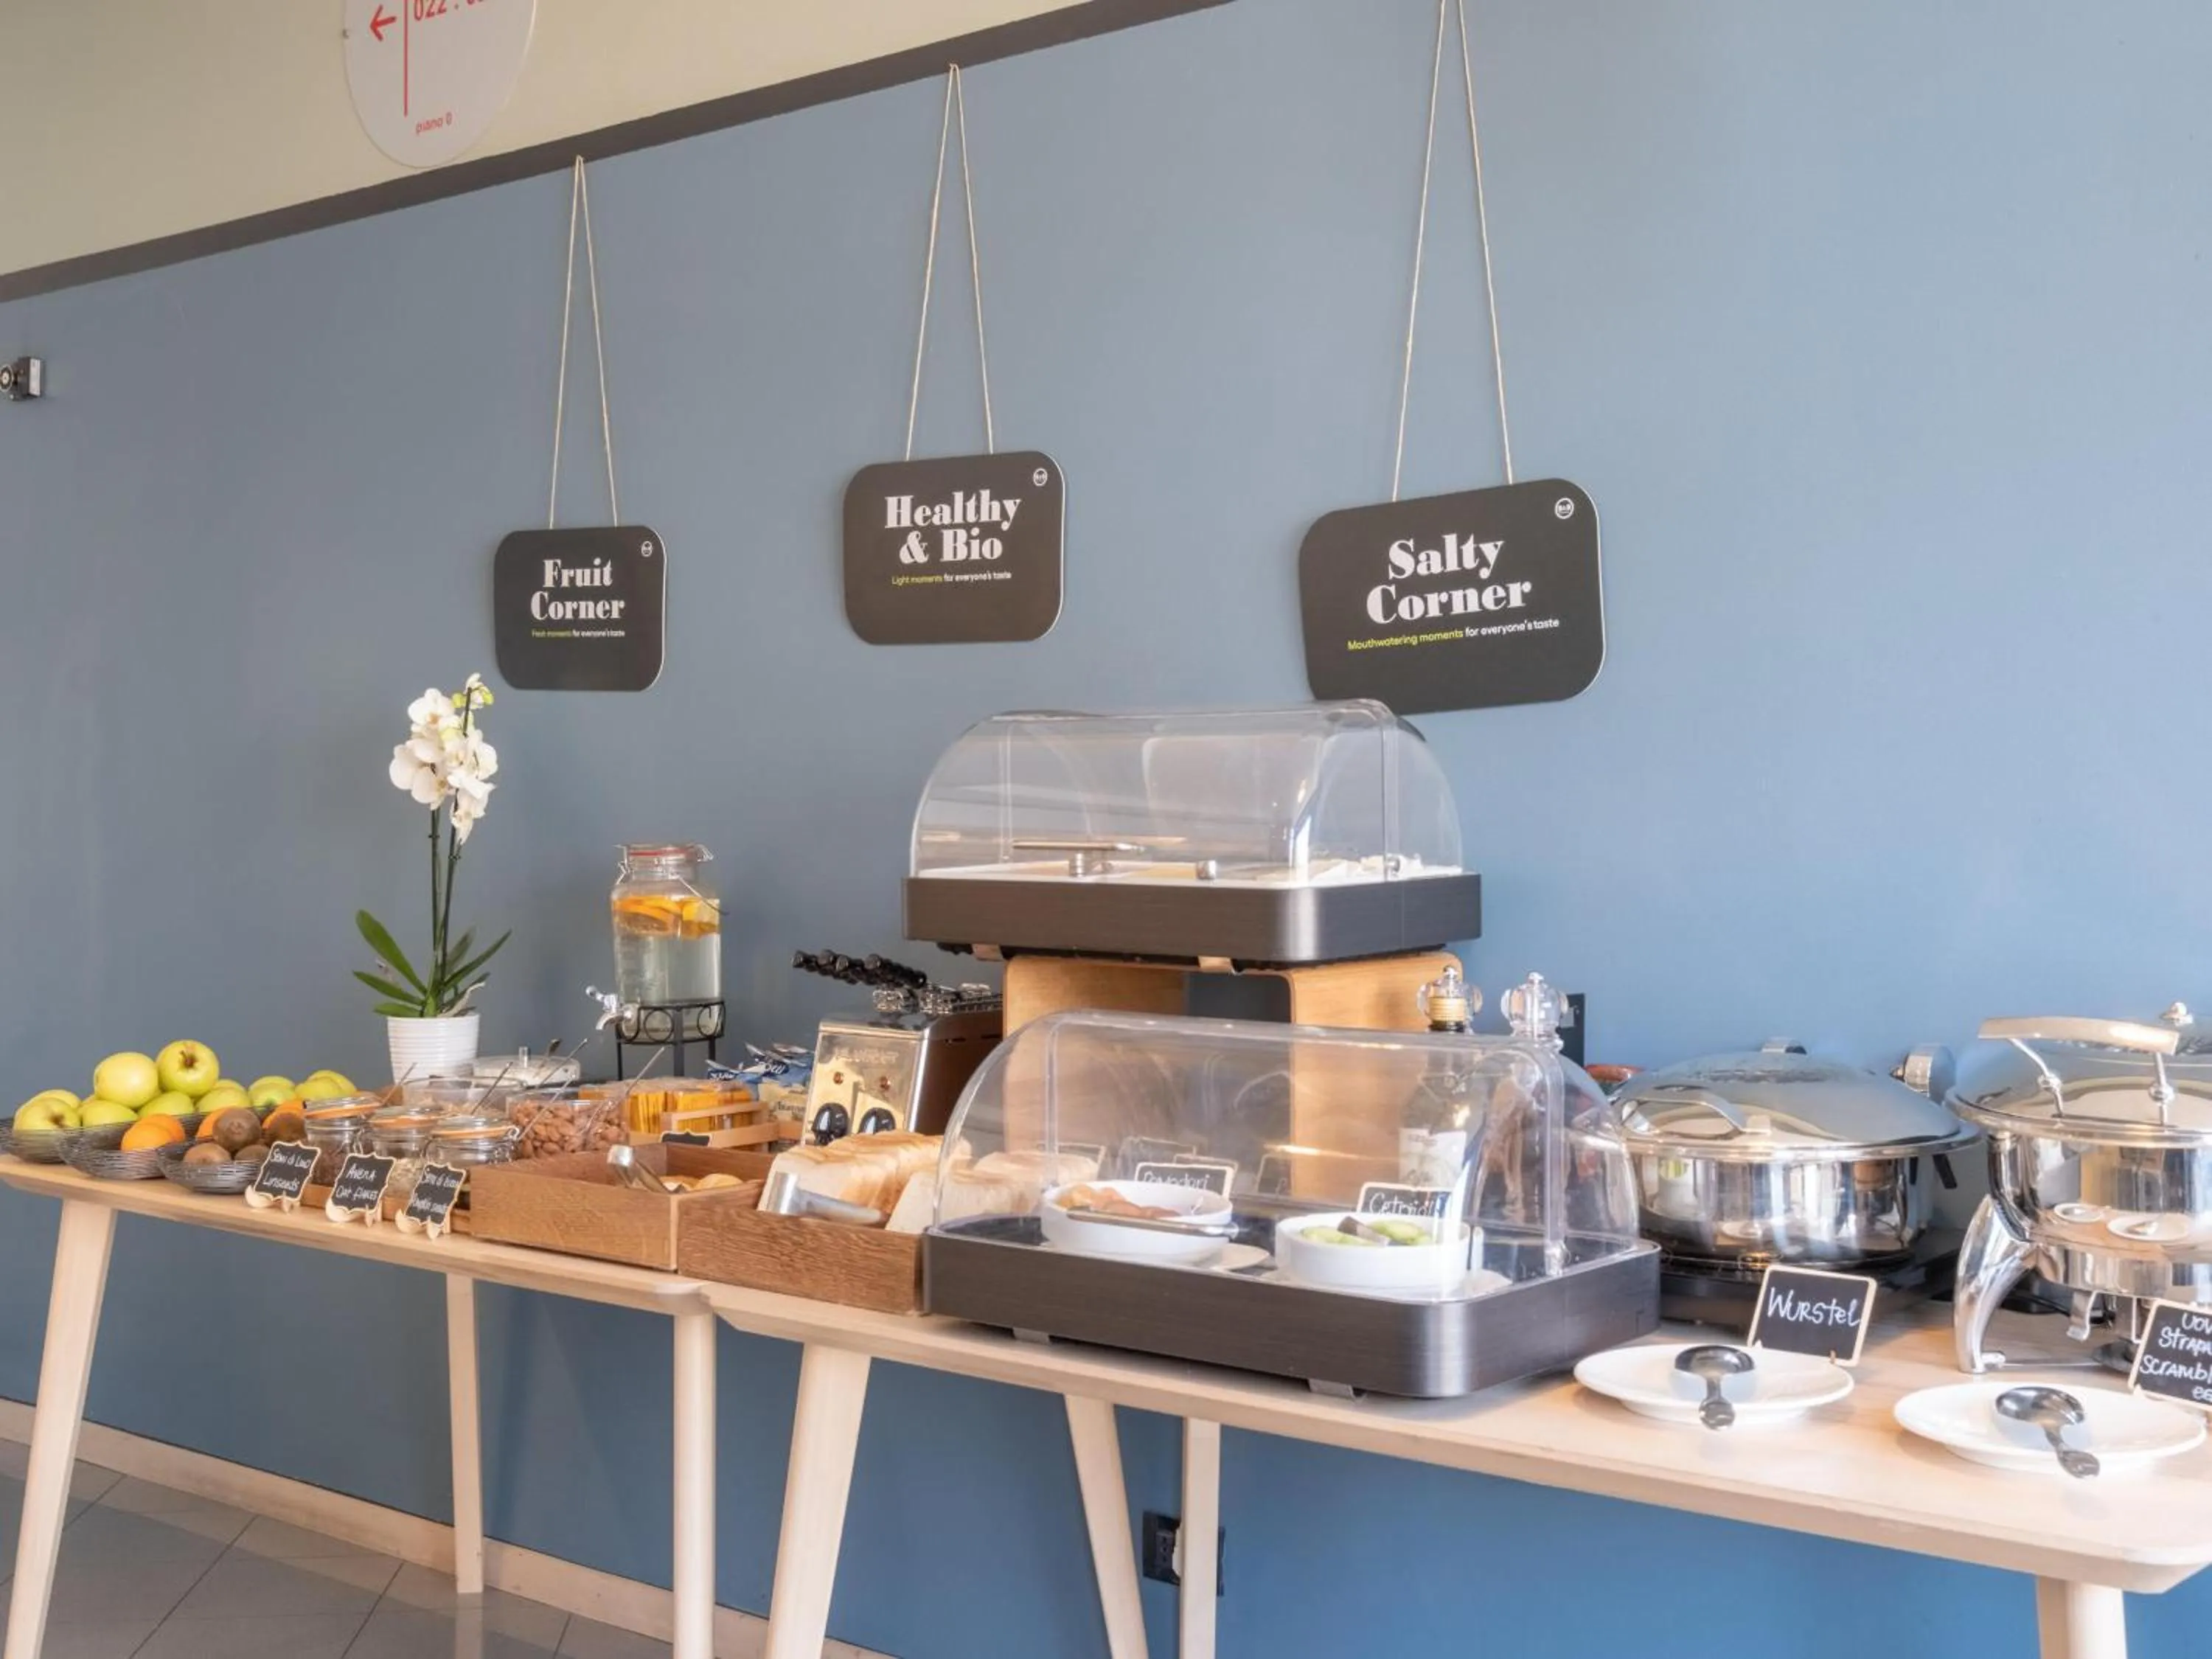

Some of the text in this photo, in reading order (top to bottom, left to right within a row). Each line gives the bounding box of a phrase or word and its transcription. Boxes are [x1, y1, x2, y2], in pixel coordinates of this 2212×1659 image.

[415, 111, 452, 136] piano 0
[885, 489, 1021, 531] Healthy
[899, 527, 1003, 564] & Bio
[1388, 532, 1505, 580] Salty
[543, 557, 613, 588] Fruit
[891, 575, 909, 586] Light
[911, 574, 943, 584] moments
[944, 572, 953, 582] for
[993, 571, 1012, 580] taste
[530, 591, 625, 620] Corner
[1367, 581, 1532, 625] Corner
[1347, 619, 1559, 650] Mouthwatering moments for everyone's taste
